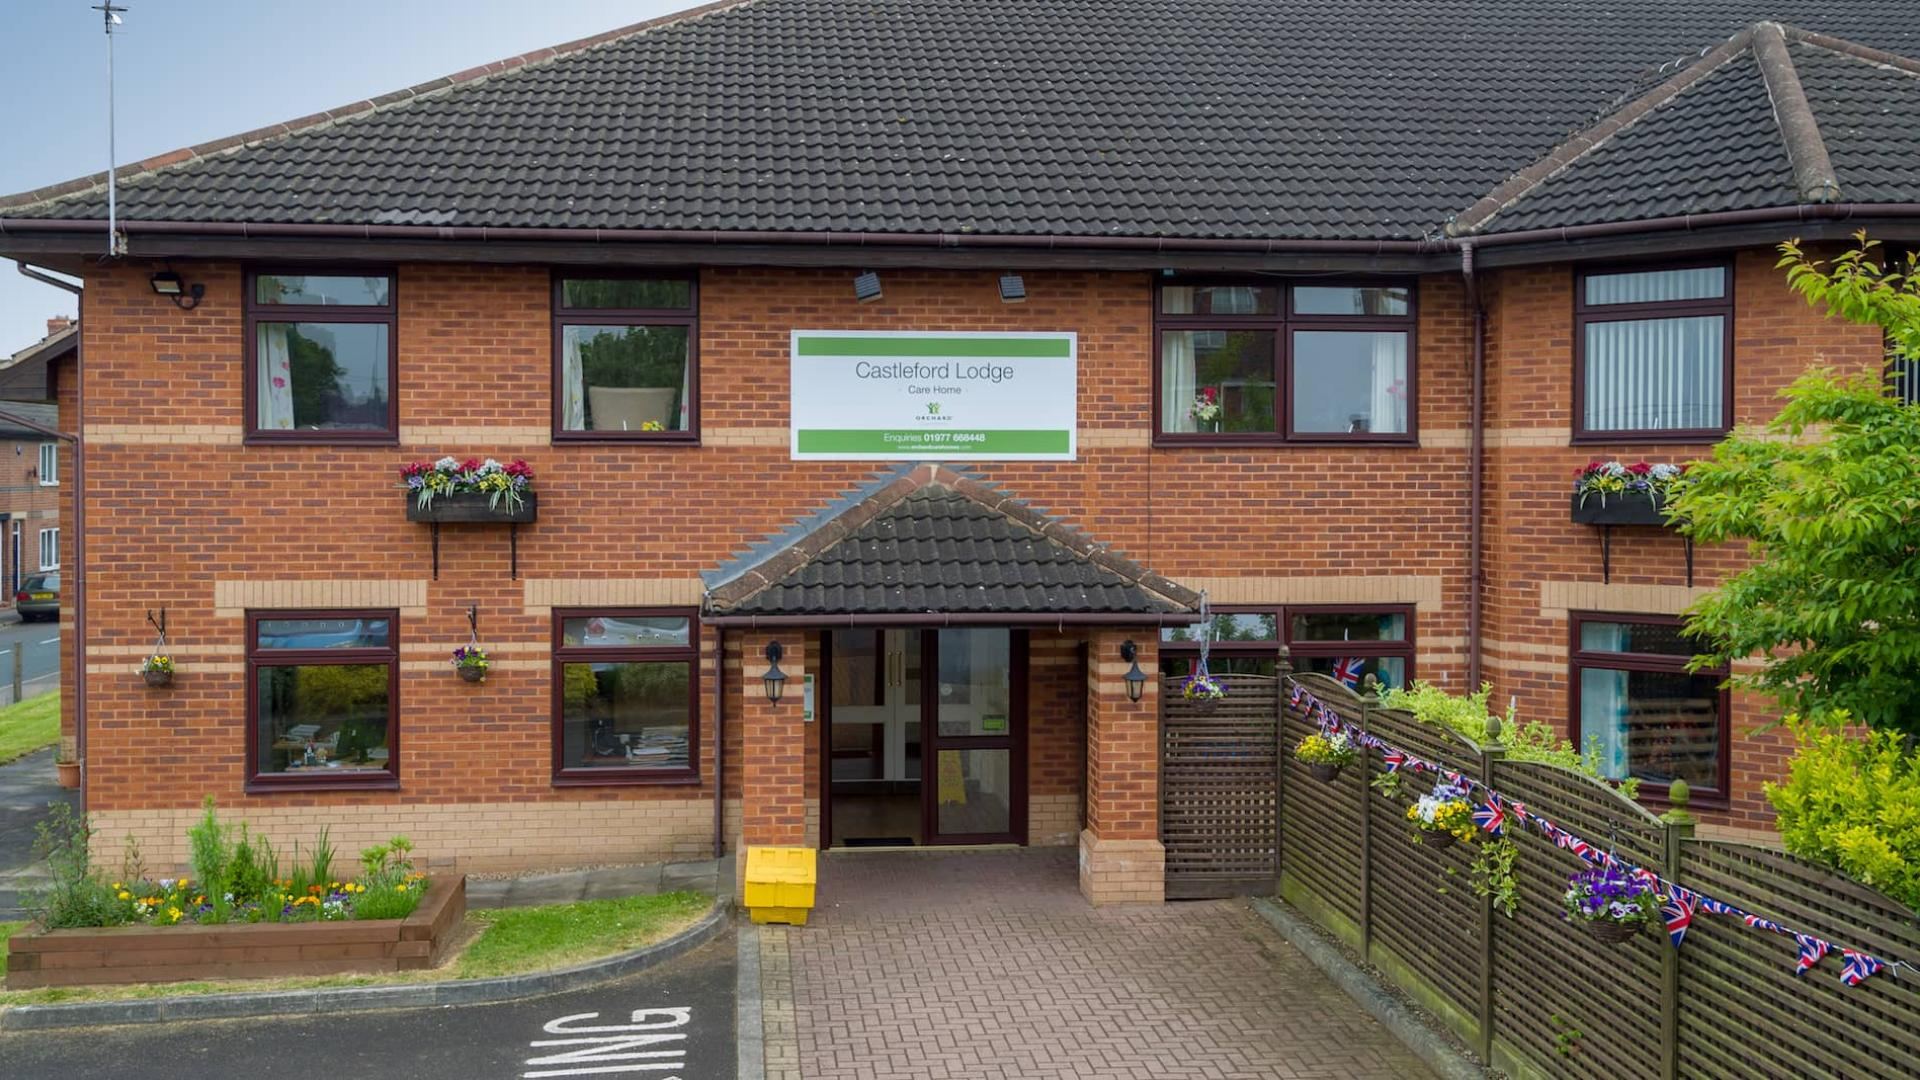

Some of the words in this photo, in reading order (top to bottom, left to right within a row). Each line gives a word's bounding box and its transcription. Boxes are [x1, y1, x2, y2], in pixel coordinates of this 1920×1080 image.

[856, 361, 949, 379] Castleford
[956, 362, 1014, 383] Lodge
[908, 384, 931, 395] Care
[933, 384, 962, 395] Home
[884, 433, 921, 444] Enquiries
[923, 433, 951, 443] 01977
[522, 1006, 691, 1080] ING
